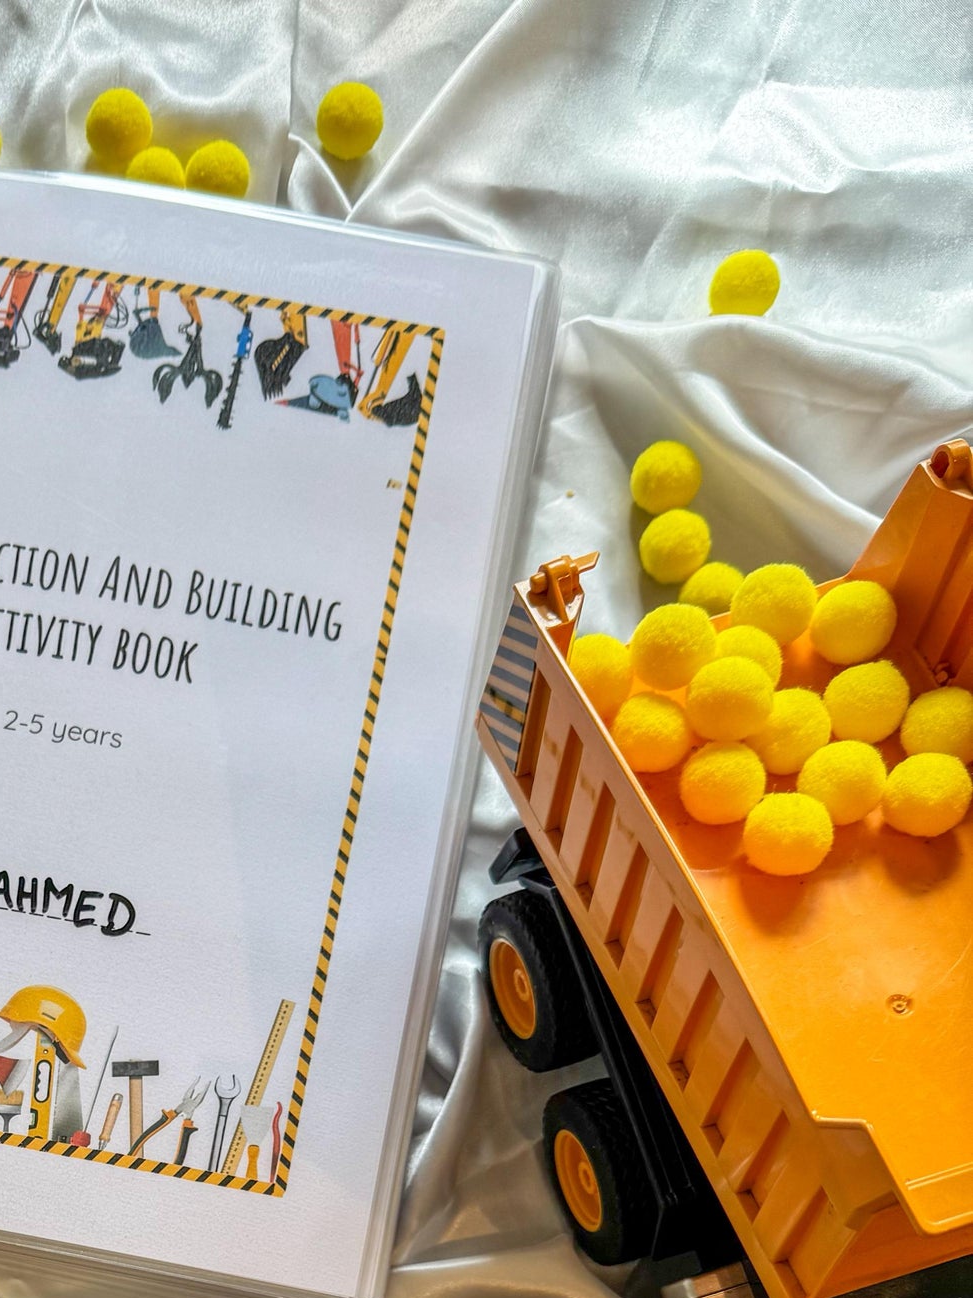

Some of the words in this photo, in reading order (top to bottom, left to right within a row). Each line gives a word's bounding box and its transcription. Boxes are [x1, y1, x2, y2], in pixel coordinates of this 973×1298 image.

[98, 555, 173, 609] AND
[184, 569, 343, 642] BUILDING
[112, 628, 199, 684] BOOK
[3, 710, 45, 734] 2-5
[51, 722, 123, 748] years
